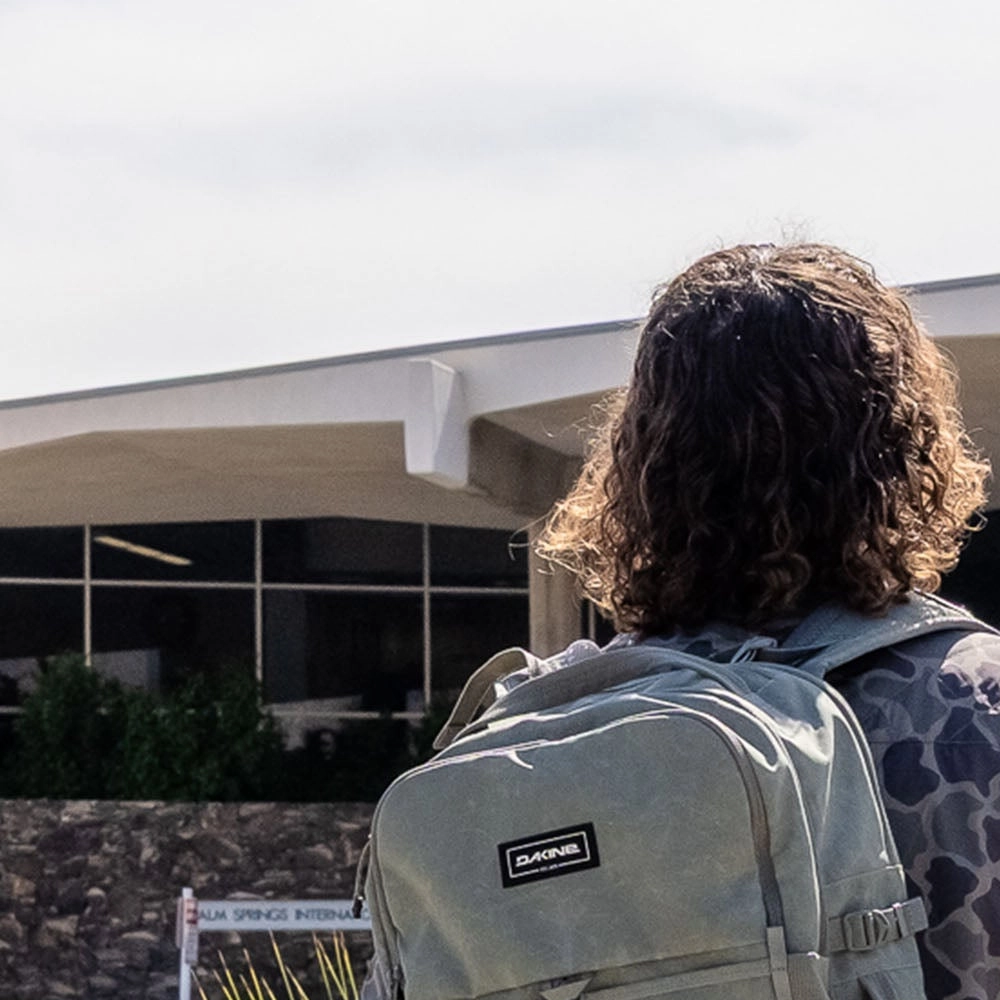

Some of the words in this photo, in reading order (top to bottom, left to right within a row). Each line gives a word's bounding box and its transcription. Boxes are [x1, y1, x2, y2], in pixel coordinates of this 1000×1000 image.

[514, 842, 581, 867] DAKINE
[199, 908, 227, 921] ALM
[233, 907, 288, 921] SPRINGS
